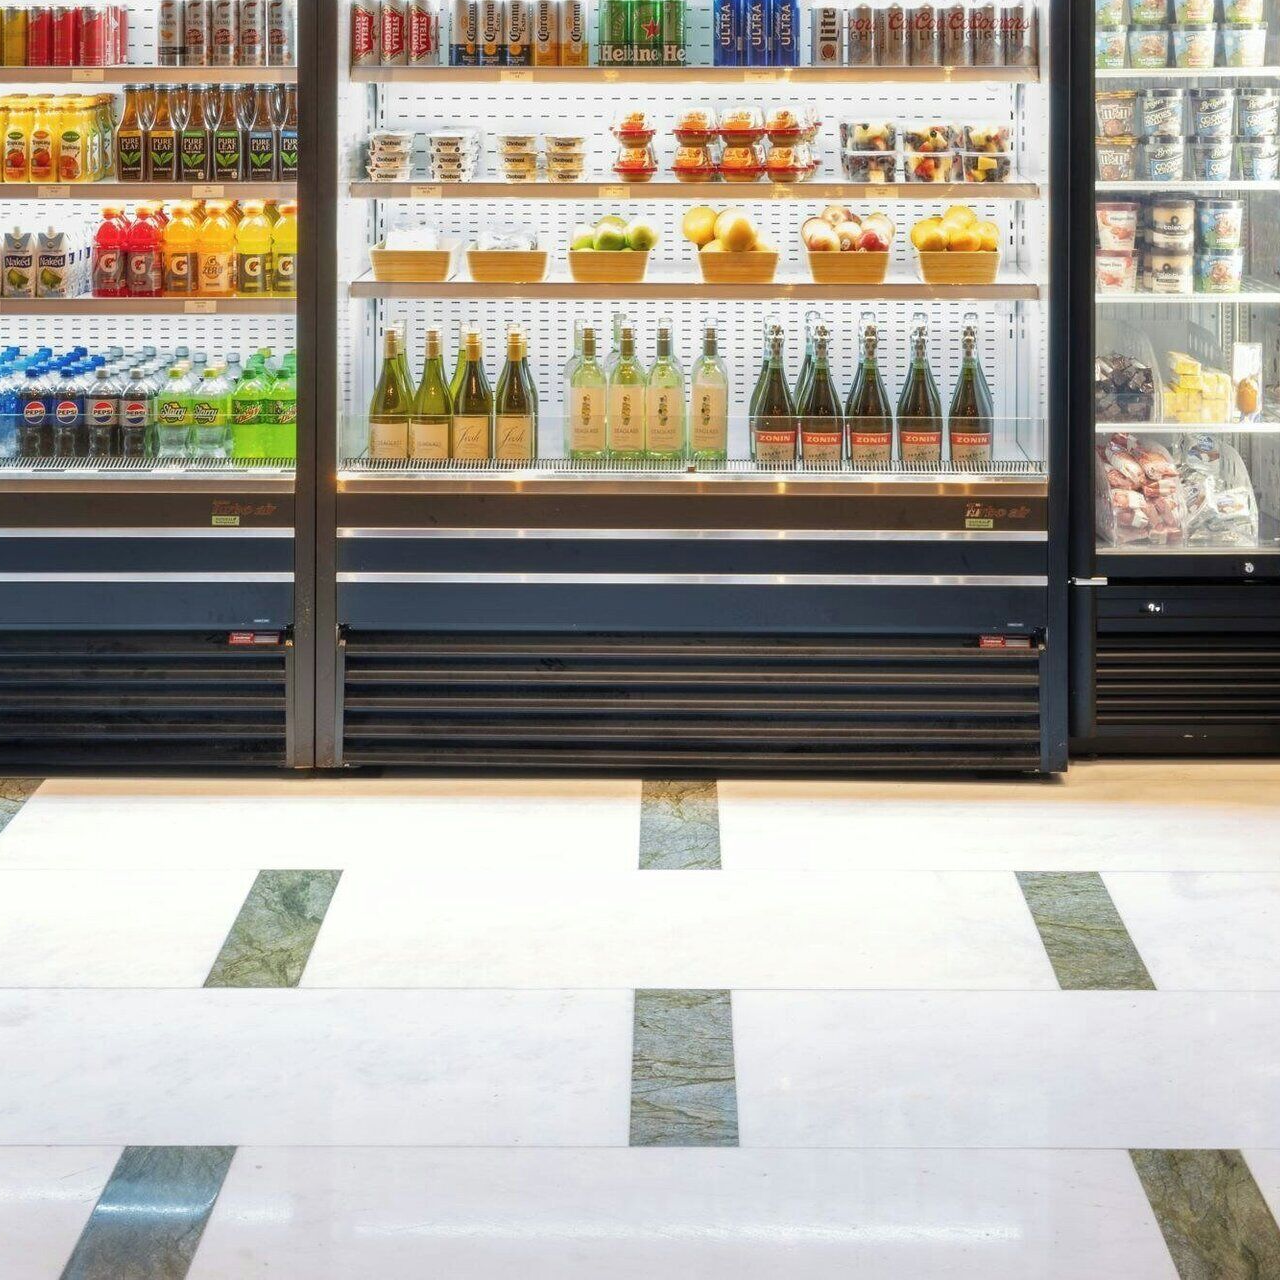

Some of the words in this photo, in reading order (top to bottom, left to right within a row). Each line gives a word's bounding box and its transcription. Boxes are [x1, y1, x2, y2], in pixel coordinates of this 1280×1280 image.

[467, 3, 475, 41] Corona
[484, 3, 495, 42] Corona
[509, 3, 520, 42] Corona
[538, 3, 548, 42] Corona
[571, 3, 580, 42] Corona
[721, 3, 730, 45] ULTRA
[752, 3, 761, 45] ULTRA
[781, 4, 791, 45] ULTRA
[5, 255, 30, 266] Naked
[39, 255, 64, 266] Naked
[100, 254, 117, 272] G
[131, 254, 146, 274] G
[172, 254, 187, 275] G
[245, 256, 261, 276] G
[278, 256, 294, 276] G
[160, 404, 186, 421] Starry
[194, 405, 217, 422] Starry
